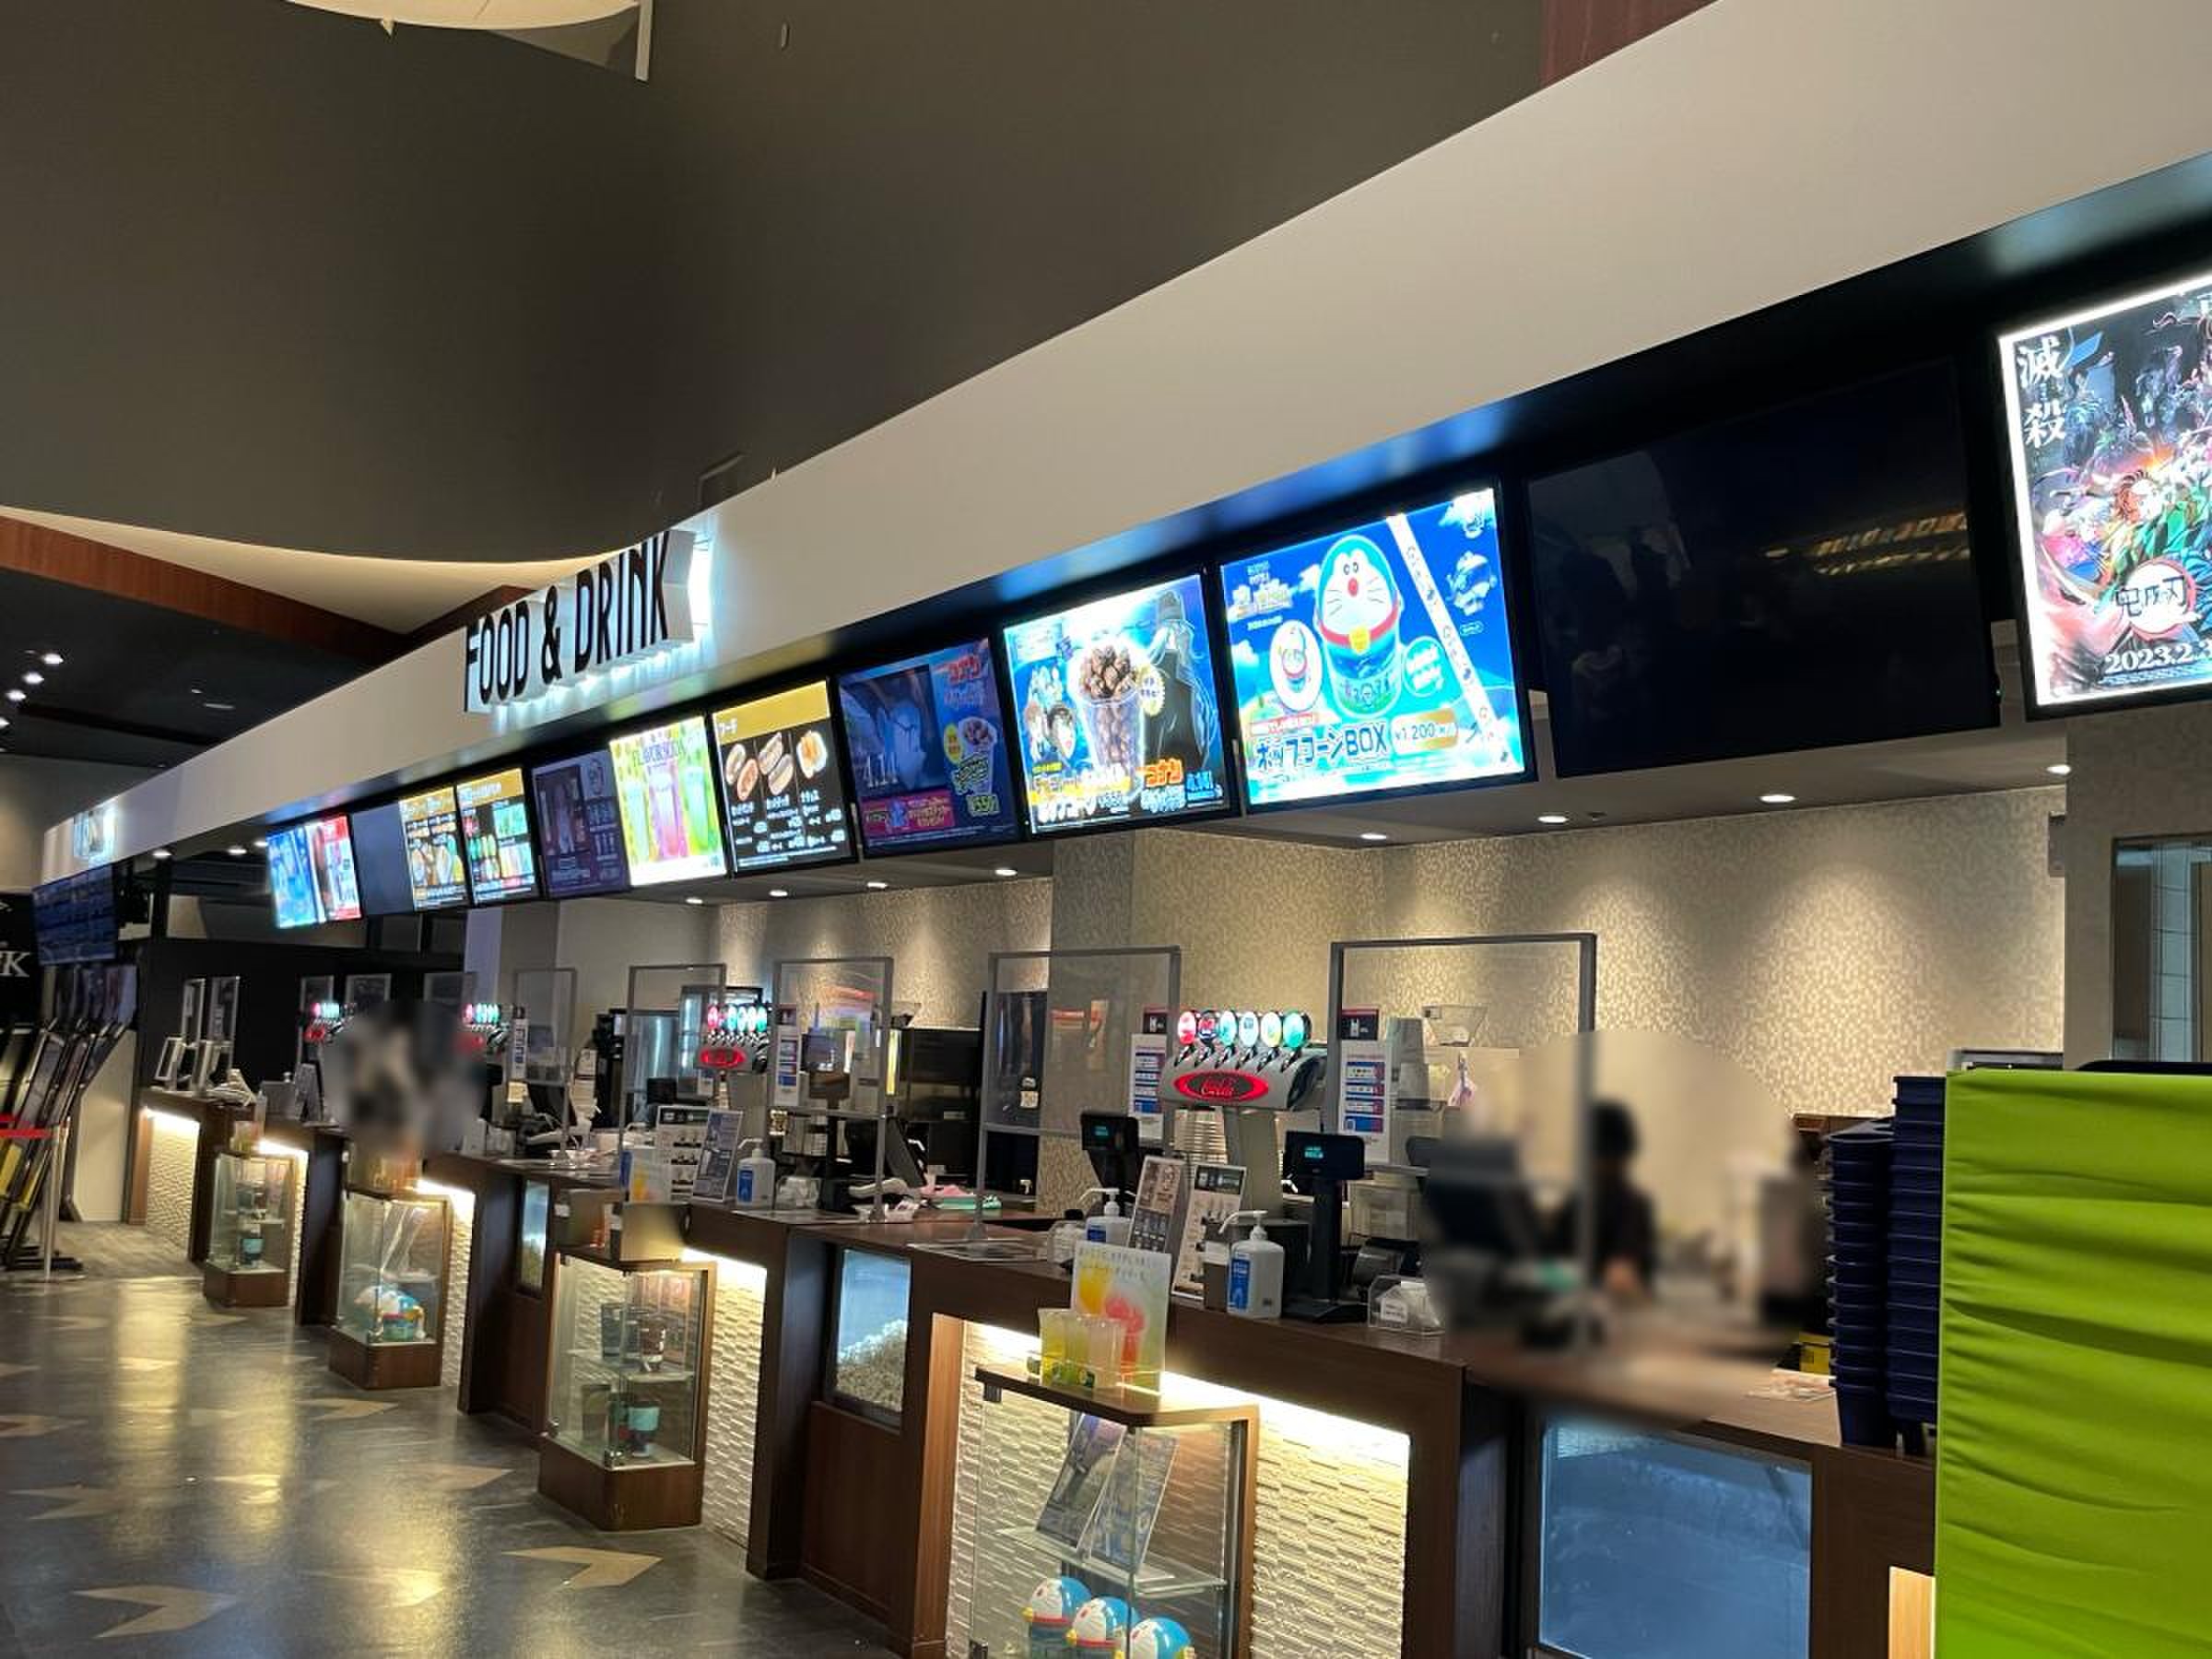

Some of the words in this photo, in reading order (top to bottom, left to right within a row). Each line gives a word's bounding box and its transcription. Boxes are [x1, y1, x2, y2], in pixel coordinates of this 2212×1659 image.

[463, 599, 531, 712] FOOD
[541, 584, 563, 685] &
[574, 530, 670, 674] DRINK
